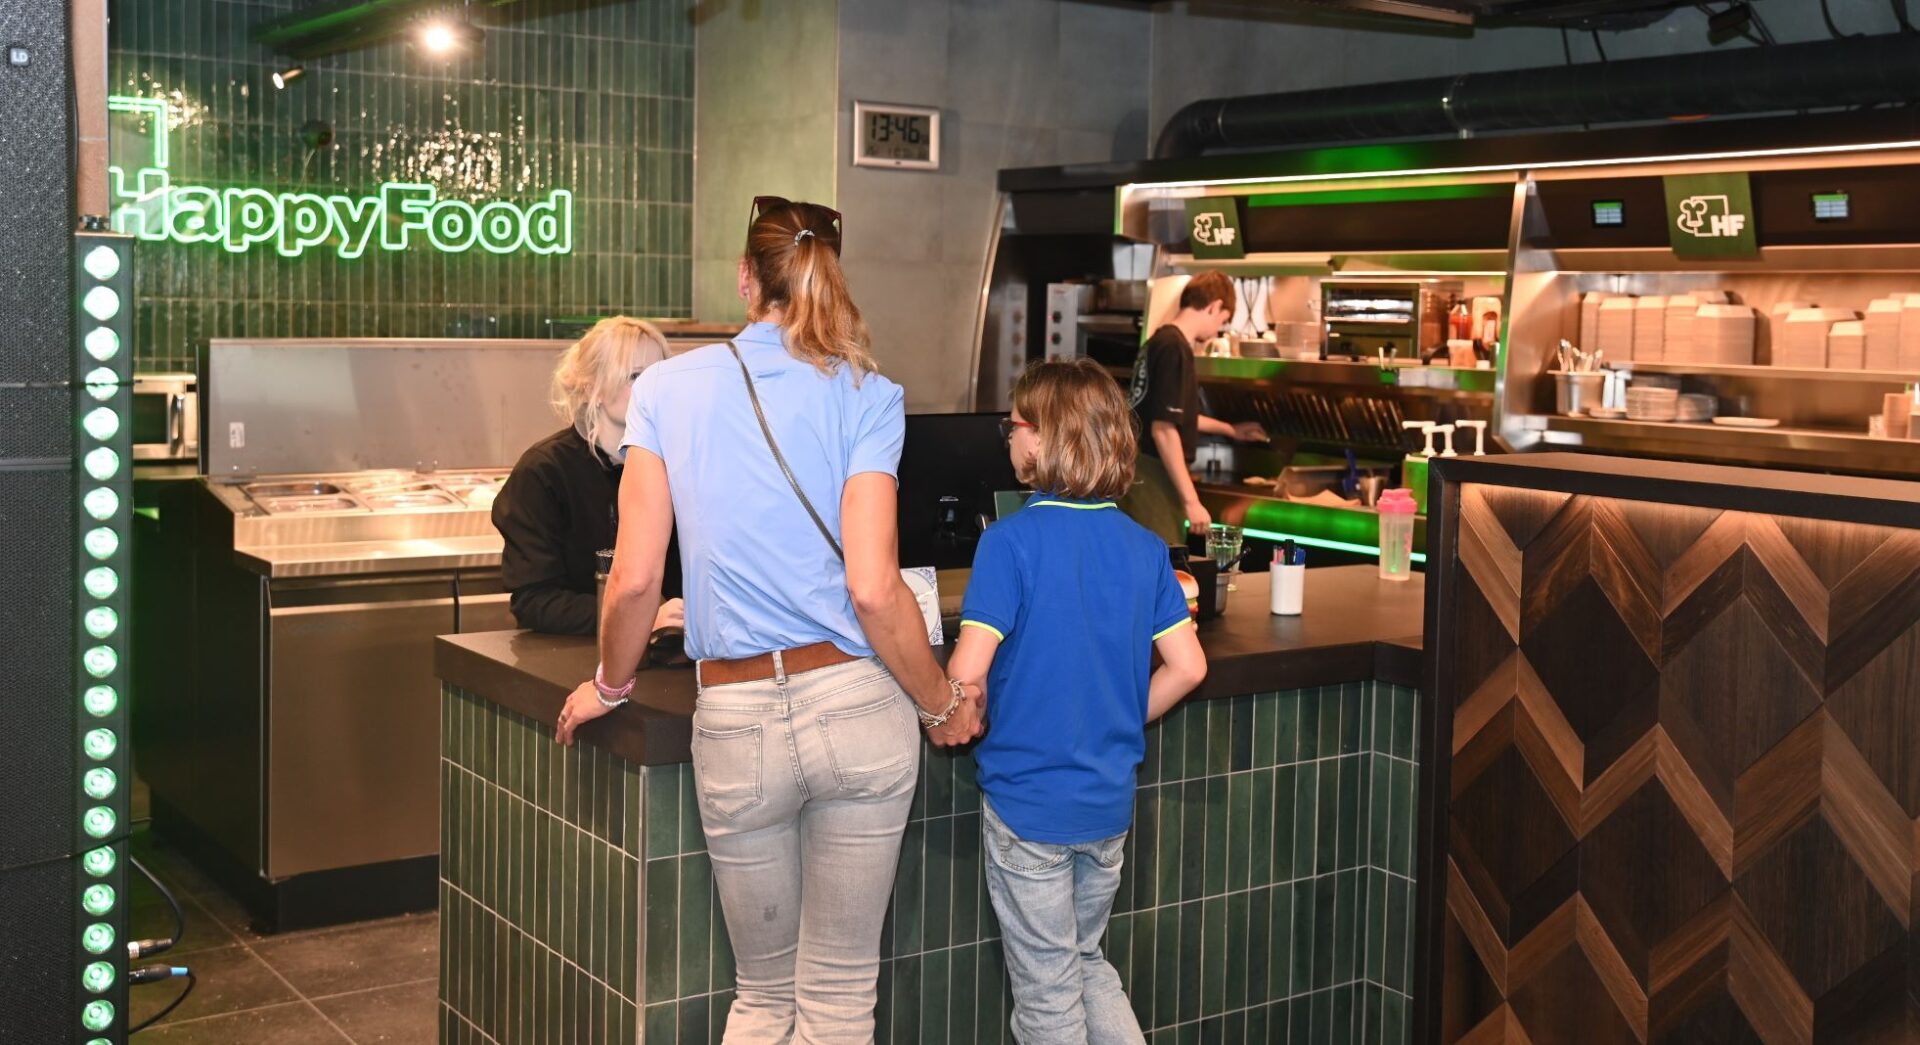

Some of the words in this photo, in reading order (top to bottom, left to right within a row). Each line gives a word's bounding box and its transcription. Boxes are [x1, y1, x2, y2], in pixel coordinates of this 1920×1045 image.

[871, 113, 920, 144] 13:46
[1213, 227, 1236, 246] HF
[1710, 214, 1746, 237] HF
